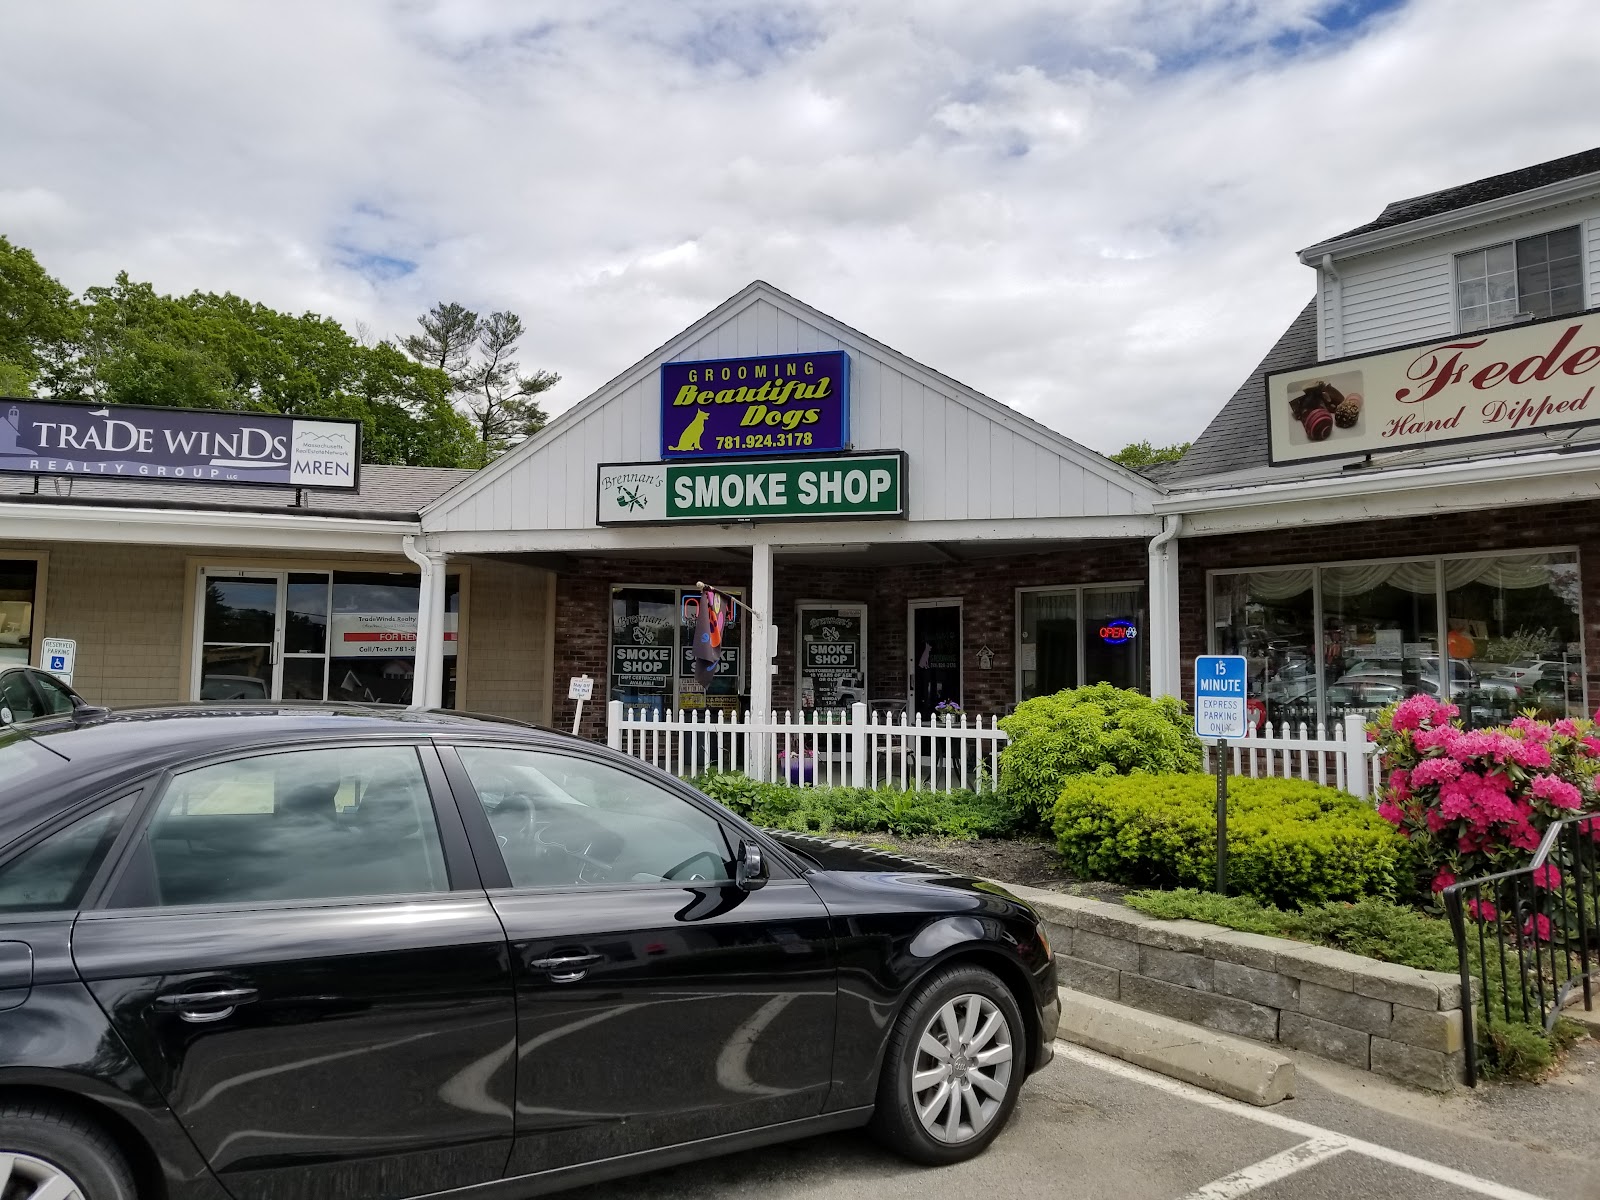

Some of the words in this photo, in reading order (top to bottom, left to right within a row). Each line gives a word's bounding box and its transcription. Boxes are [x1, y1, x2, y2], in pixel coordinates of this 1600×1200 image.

[688, 361, 814, 383] GROOMING
[672, 376, 832, 406] Beautiful
[739, 405, 821, 430] Dogs
[1381, 406, 1466, 438] Hand
[1481, 386, 1596, 429] Dipped
[32, 419, 154, 453] TRADE
[163, 427, 287, 460] WINDS
[715, 432, 813, 450] 781.924.3178
[30, 459, 125, 474] REALTY
[138, 465, 220, 478] GROUP
[293, 459, 349, 476] MREN
[601, 472, 664, 491] Brennan's
[674, 472, 788, 509] SMOKE
[797, 469, 892, 504] SHOP
[400, 633, 418, 641] REN
[1099, 627, 1126, 638] OPEN
[45, 641, 73, 649] RESERVED
[810, 645, 853, 654] SMOKE
[616, 649, 669, 660] SMOKE
[684, 650, 736, 661] SKE
[815, 655, 848, 664] SHOP
[622, 661, 663, 672] SHOP
[1215, 663, 1226, 676] 15
[1201, 679, 1241, 691] MINUTE
[1203, 700, 1238, 709] EXPRESS
[1204, 711, 1237, 720] PARKING
[1210, 723, 1232, 732] ONLY
